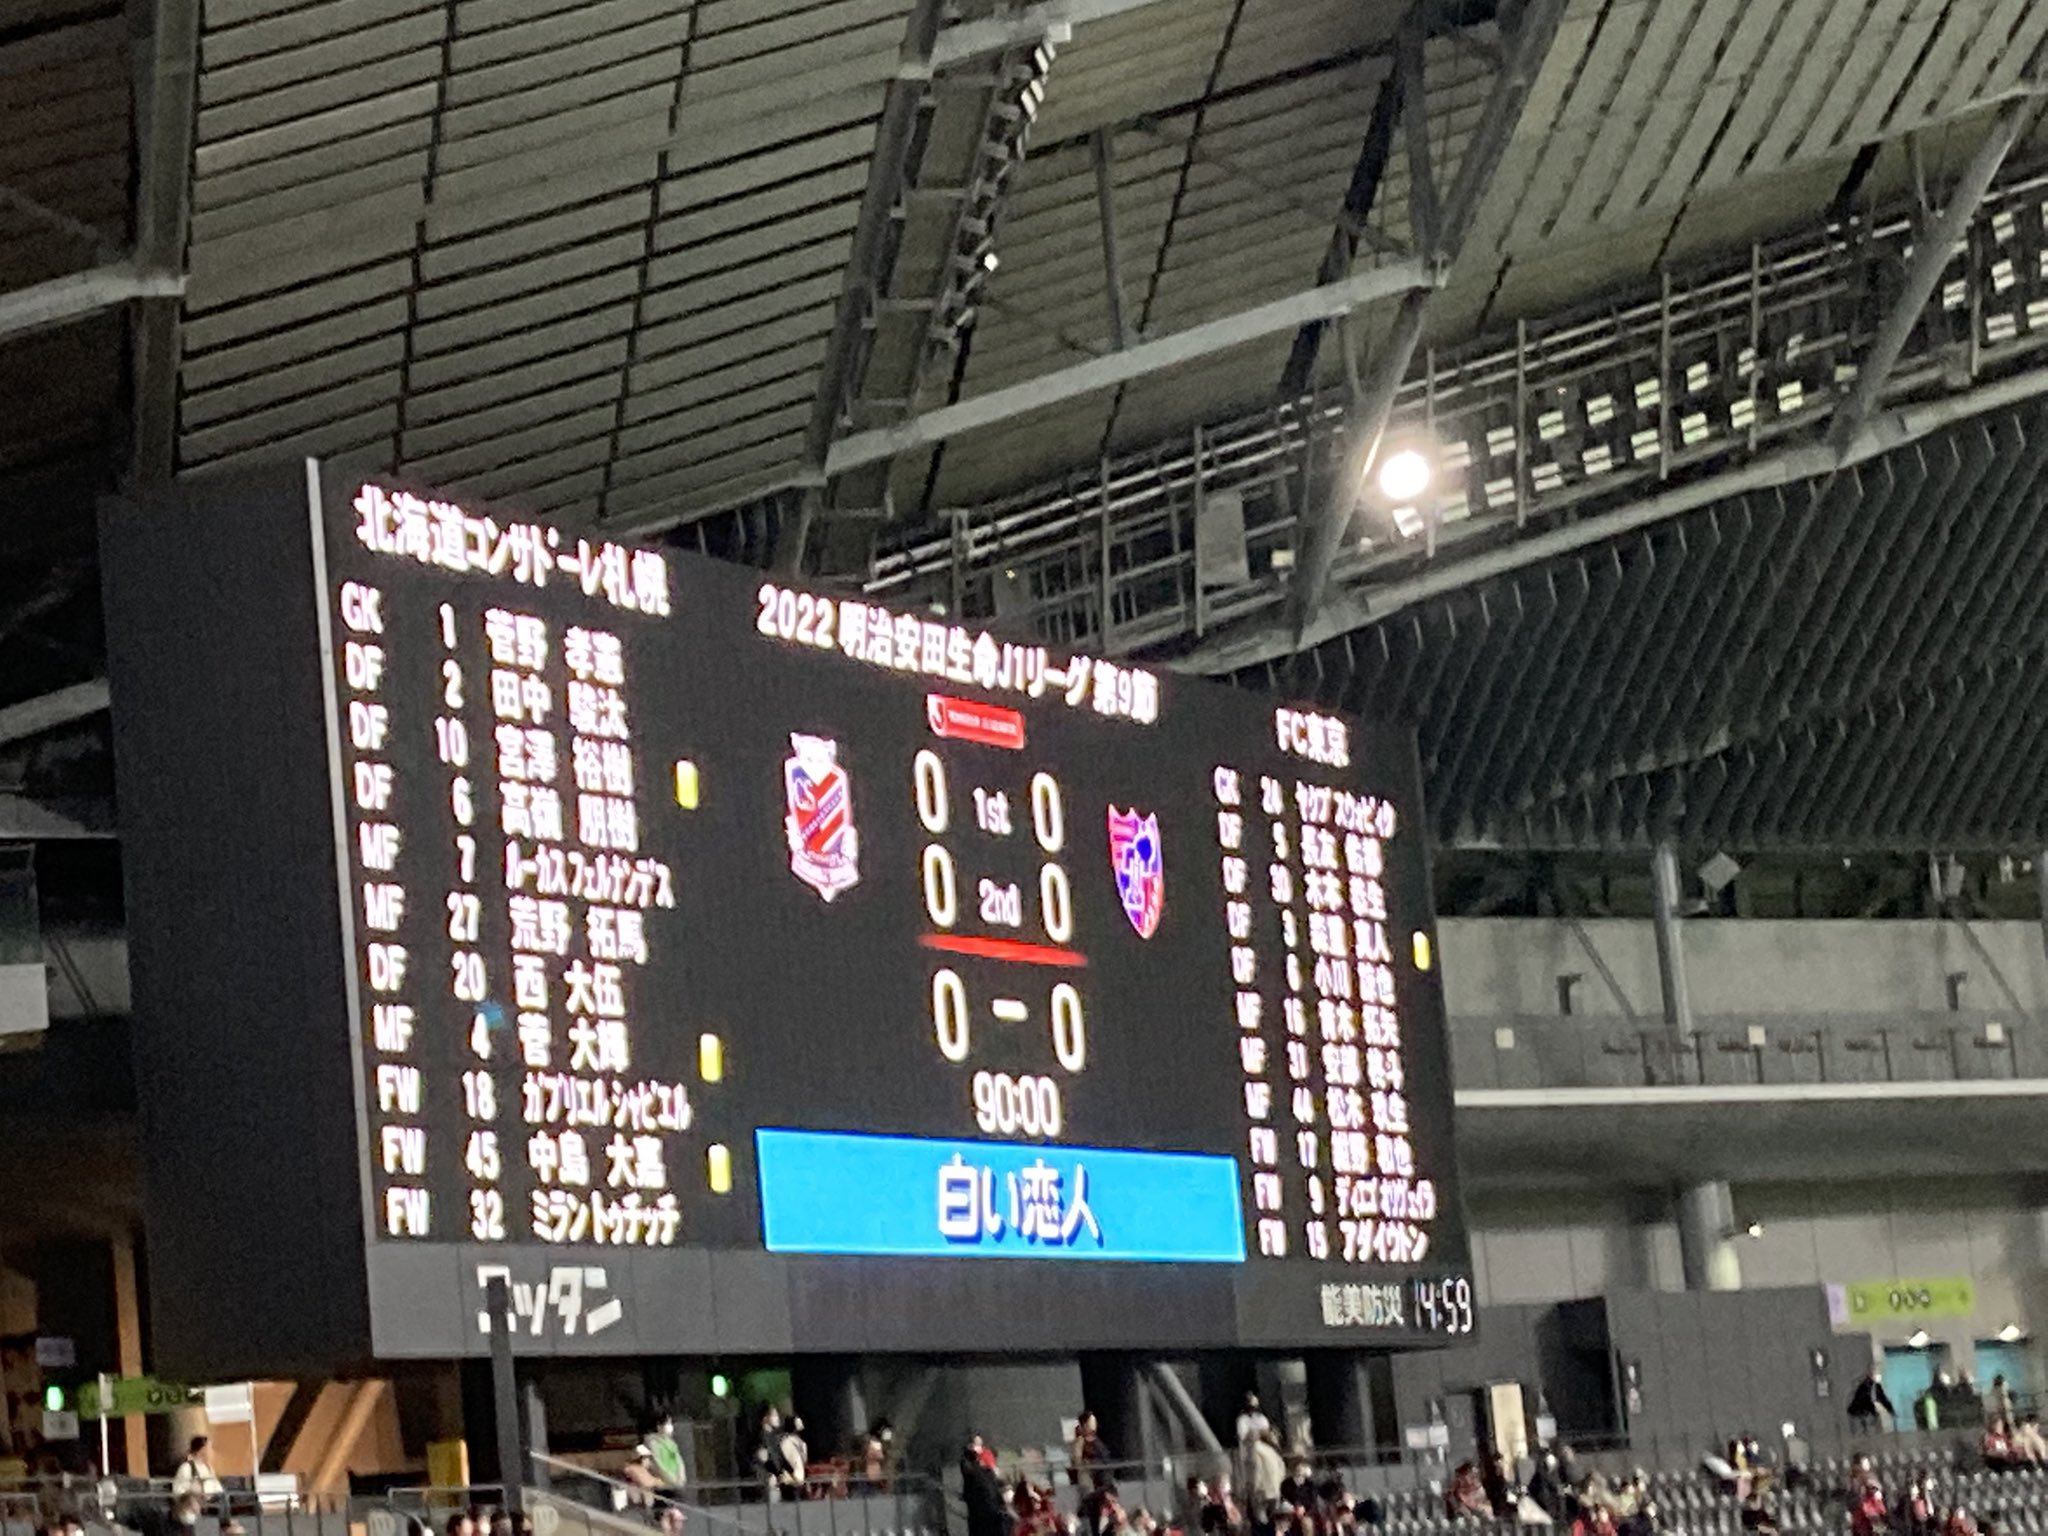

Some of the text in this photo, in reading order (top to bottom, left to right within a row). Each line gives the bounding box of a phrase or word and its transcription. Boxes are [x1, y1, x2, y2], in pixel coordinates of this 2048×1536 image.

[353, 483, 671, 617] 北海道コンサドーレ札幌
[341, 581, 384, 634] GK
[439, 603, 457, 649] 1
[757, 583, 835, 649] 2022
[345, 641, 386, 691] DF
[442, 659, 464, 709] 2
[491, 669, 553, 725] 田中
[349, 700, 389, 750] DF
[434, 716, 469, 767] 10
[354, 761, 395, 811] DF
[452, 775, 474, 826] 6
[914, 749, 949, 833] 0
[972, 787, 1013, 835] 1st
[1031, 772, 1064, 853] 0
[359, 821, 400, 871] MF
[457, 835, 477, 883] 7
[363, 881, 405, 931] MF
[446, 891, 481, 942] 27
[509, 895, 572, 956] 荒野
[923, 843, 1071, 942] 0 2nd 0
[368, 942, 626, 1017] DF 20 西 大伍
[373, 1003, 415, 1052] MF
[471, 1012, 493, 1060] 4
[517, 1011, 552, 1067] 菅
[933, 969, 969, 1061] 0
[1051, 983, 1085, 1072] 0
[377, 1064, 420, 1114] FW
[462, 1070, 497, 1121] 18
[973, 1071, 1062, 1137] 90:00
[381, 1125, 426, 1175] FW
[465, 1130, 501, 1180] 45
[528, 1129, 590, 1186] 中島
[386, 1187, 430, 1236] FW
[470, 1189, 505, 1241] 32
[938, 1152, 1101, 1241] 白い恋人
[1413, 1277, 1474, 1336] 14:59
